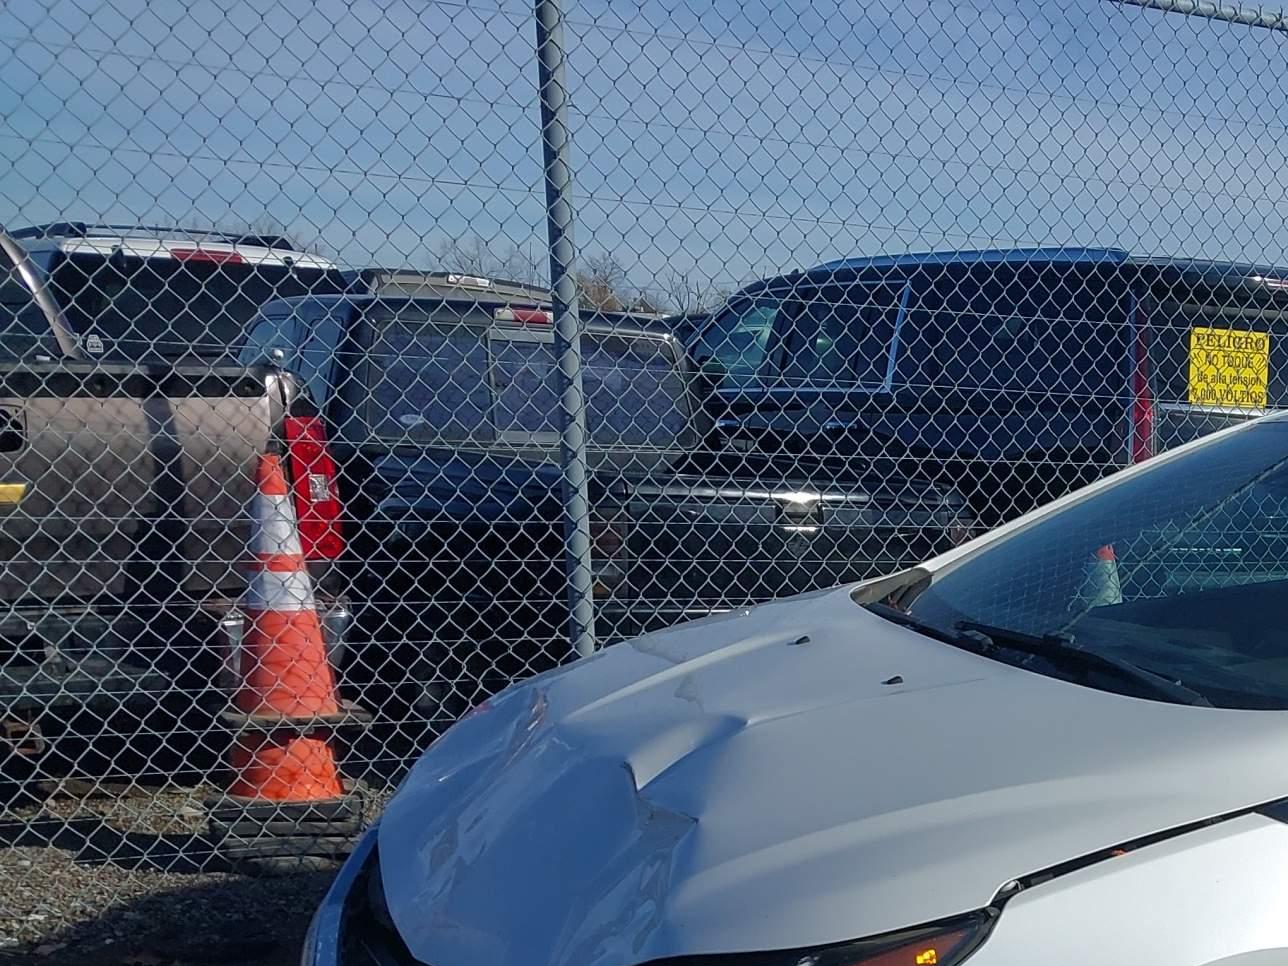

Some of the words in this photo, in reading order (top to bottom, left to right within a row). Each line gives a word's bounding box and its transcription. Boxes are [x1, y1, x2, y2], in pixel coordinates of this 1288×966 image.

[1195, 333, 1265, 351] PELIGRO
[1206, 352, 1219, 366] NO
[1222, 353, 1254, 369] TOQUE
[1219, 388, 1264, 404] VOLTIOS
